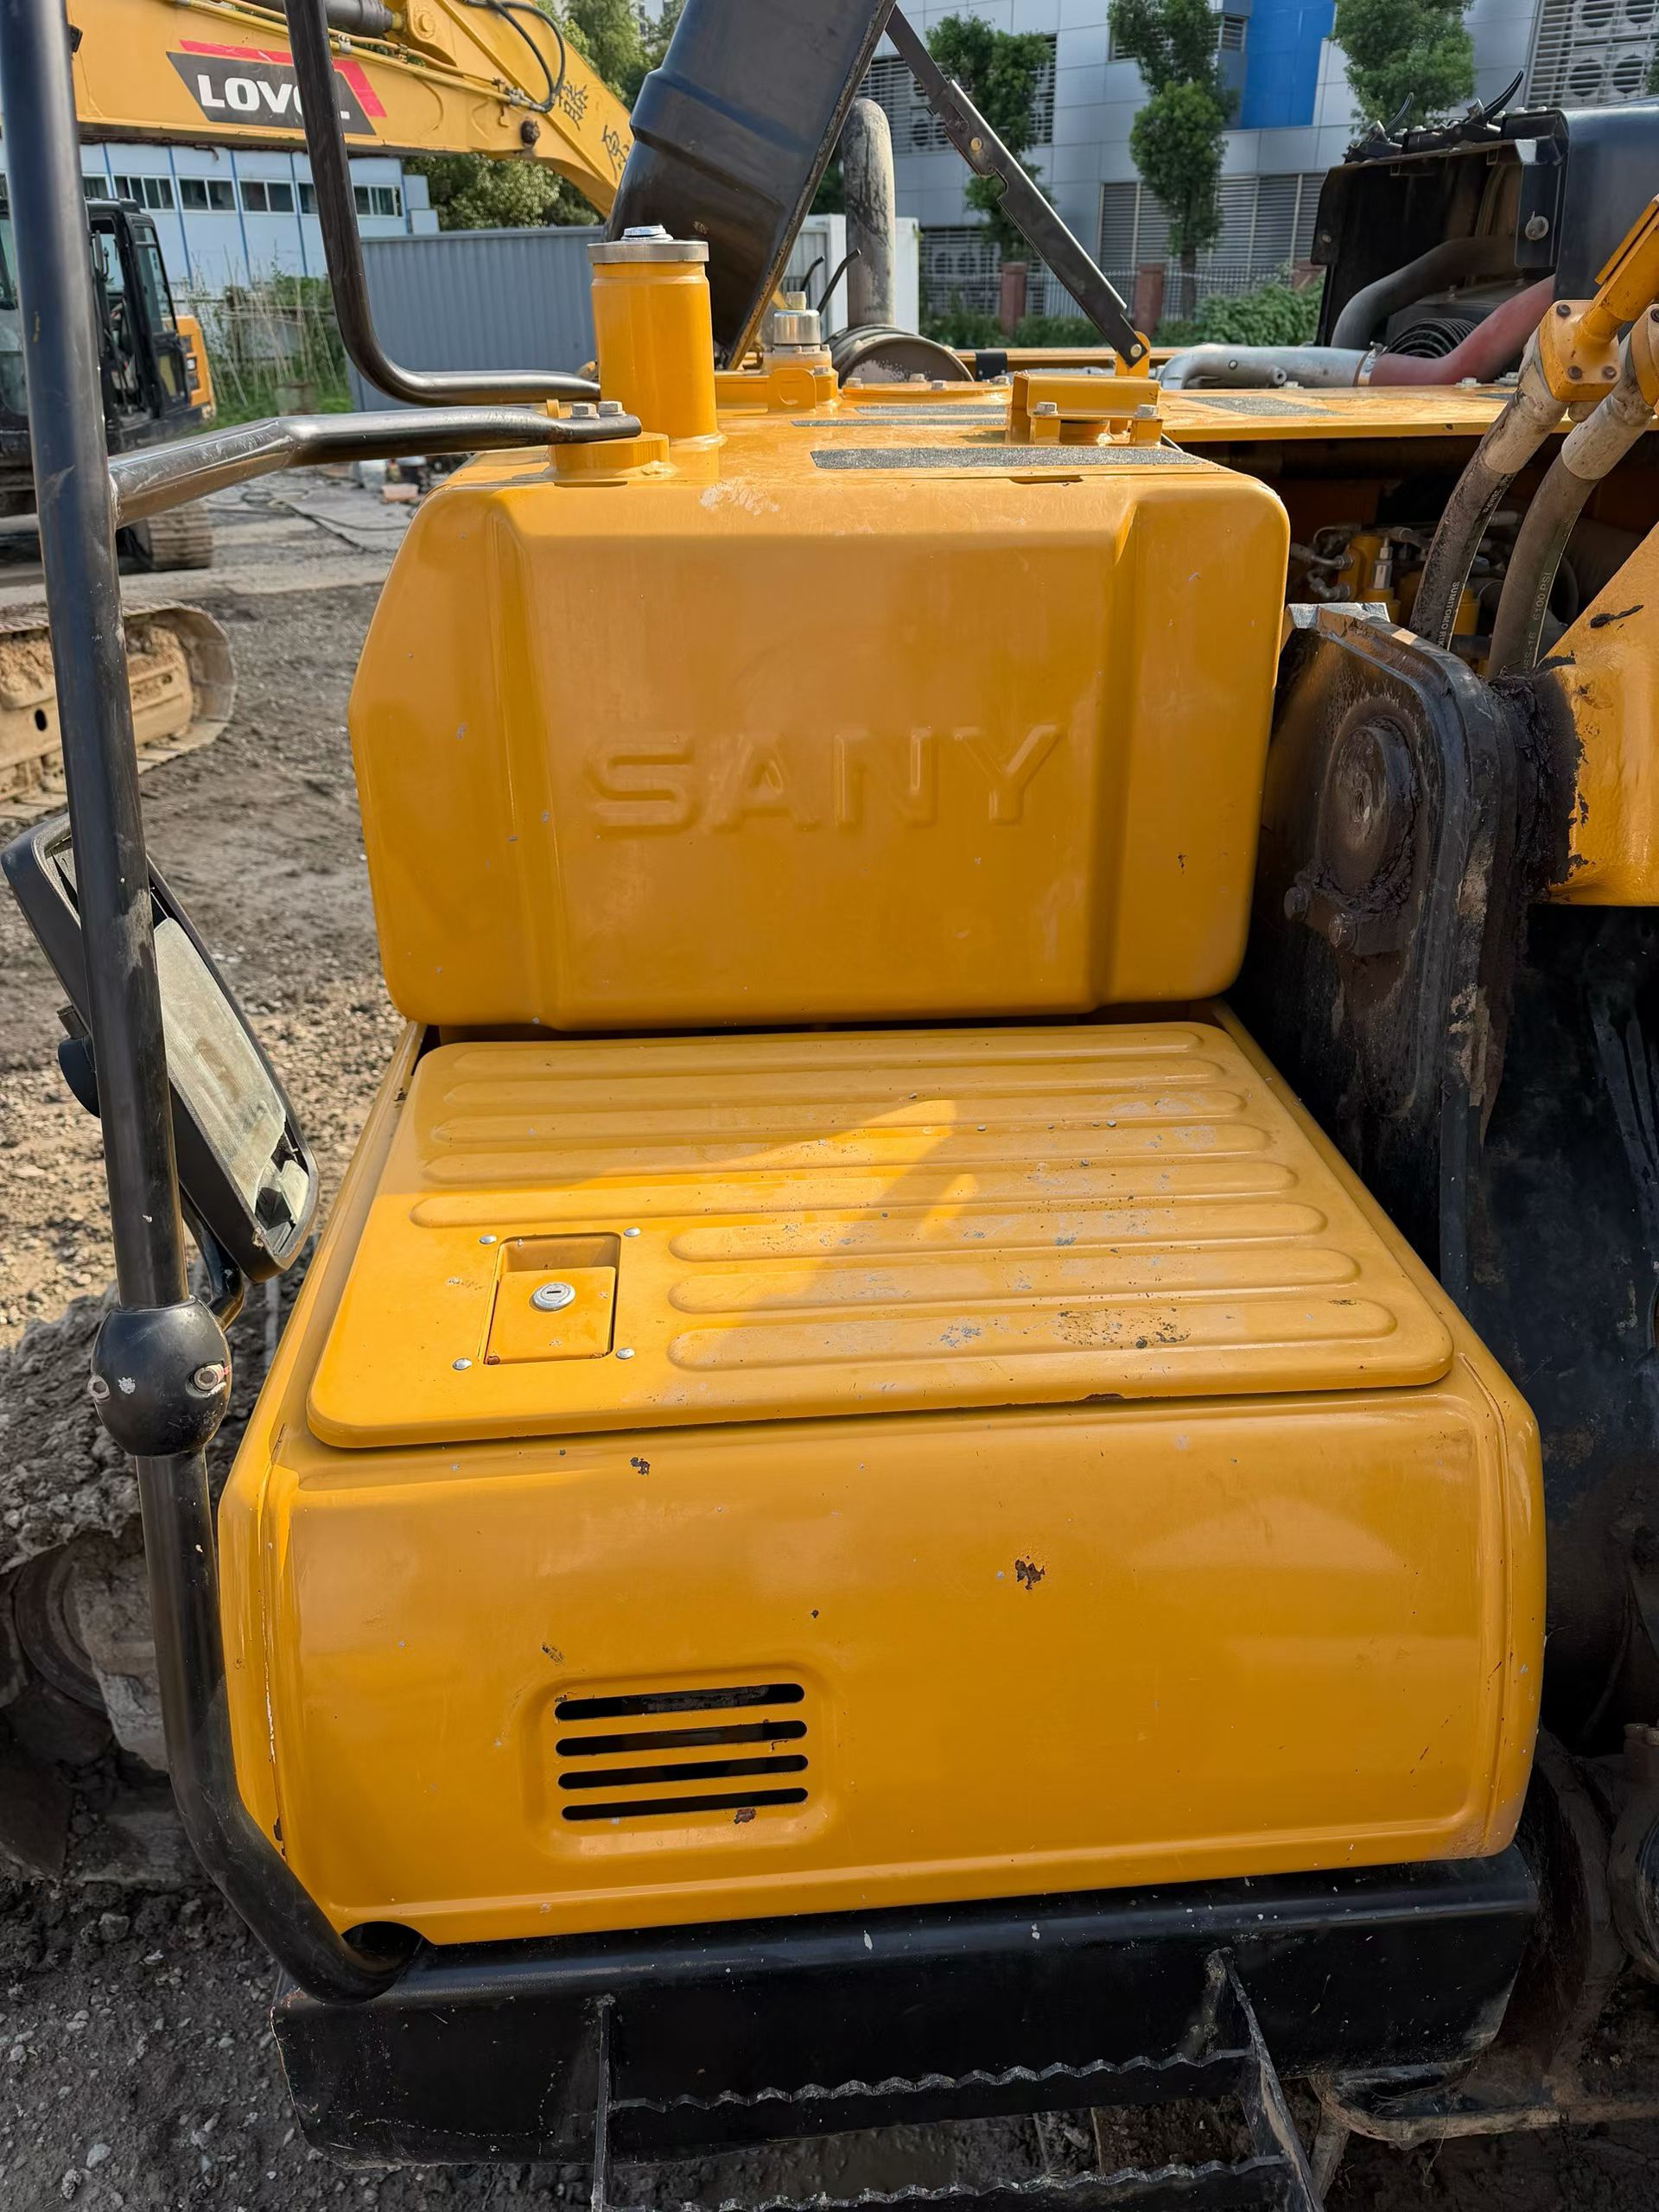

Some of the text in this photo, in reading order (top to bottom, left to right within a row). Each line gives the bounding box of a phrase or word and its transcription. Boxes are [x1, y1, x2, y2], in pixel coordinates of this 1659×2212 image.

[197, 73, 350, 119] LOV
[1437, 582, 1460, 647] SUMITOMO RIK
[1533, 593, 1545, 621] 6100
[1540, 572, 1553, 590] PSI
[589, 724, 1063, 835] SANY
